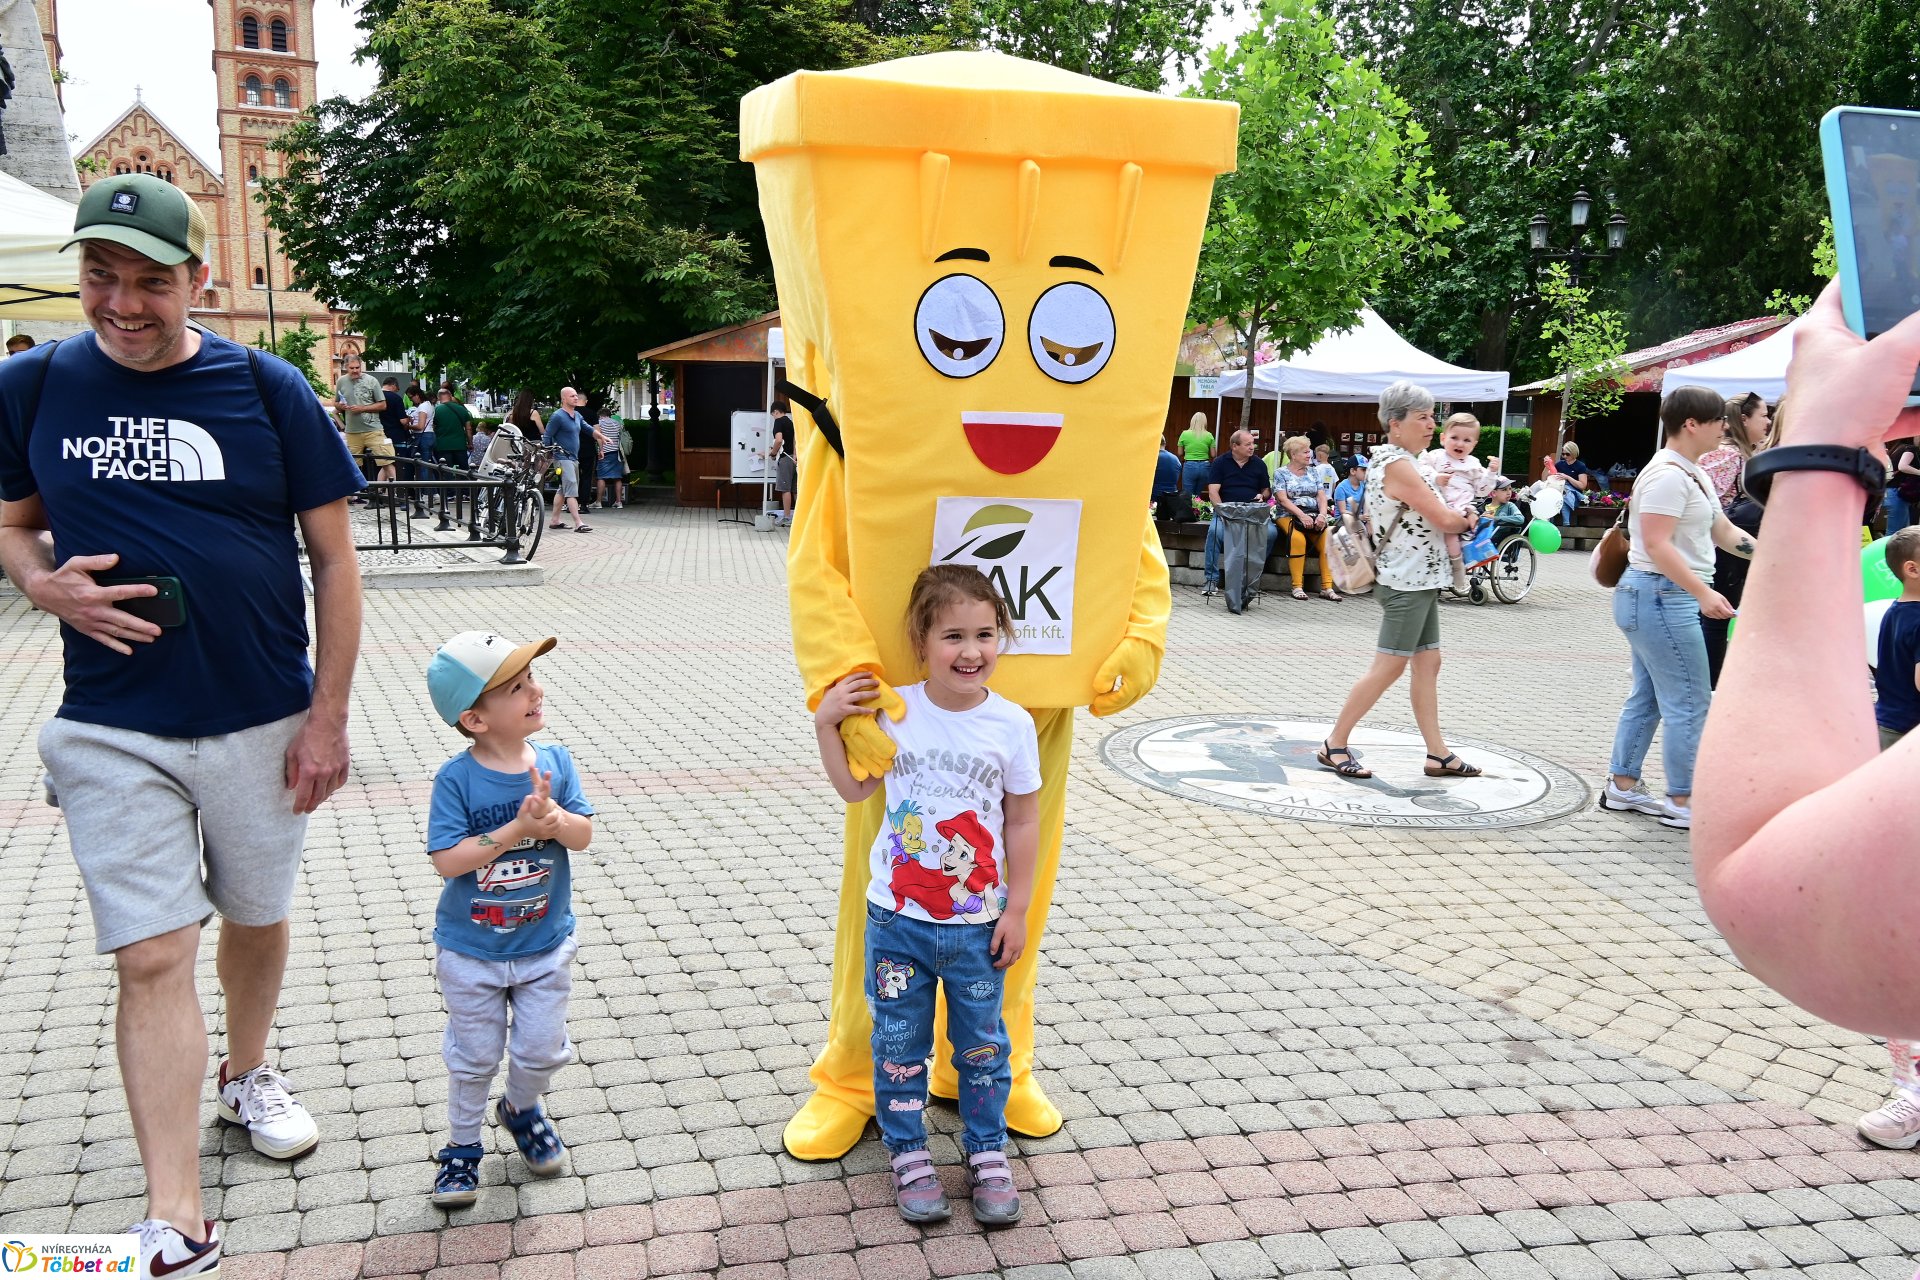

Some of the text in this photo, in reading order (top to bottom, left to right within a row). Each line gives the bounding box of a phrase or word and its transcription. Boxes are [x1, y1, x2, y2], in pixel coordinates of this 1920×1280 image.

[107, 416, 166, 438] THE
[62, 437, 167, 459] NORTH
[92, 458, 168, 481] FACE
[967, 565, 1063, 621] AK
[1041, 624, 1065, 639] Kft.
[1276, 796, 1391, 815] MARS
[877, 1023, 919, 1041] yourself
[884, 1014, 907, 1033] love
